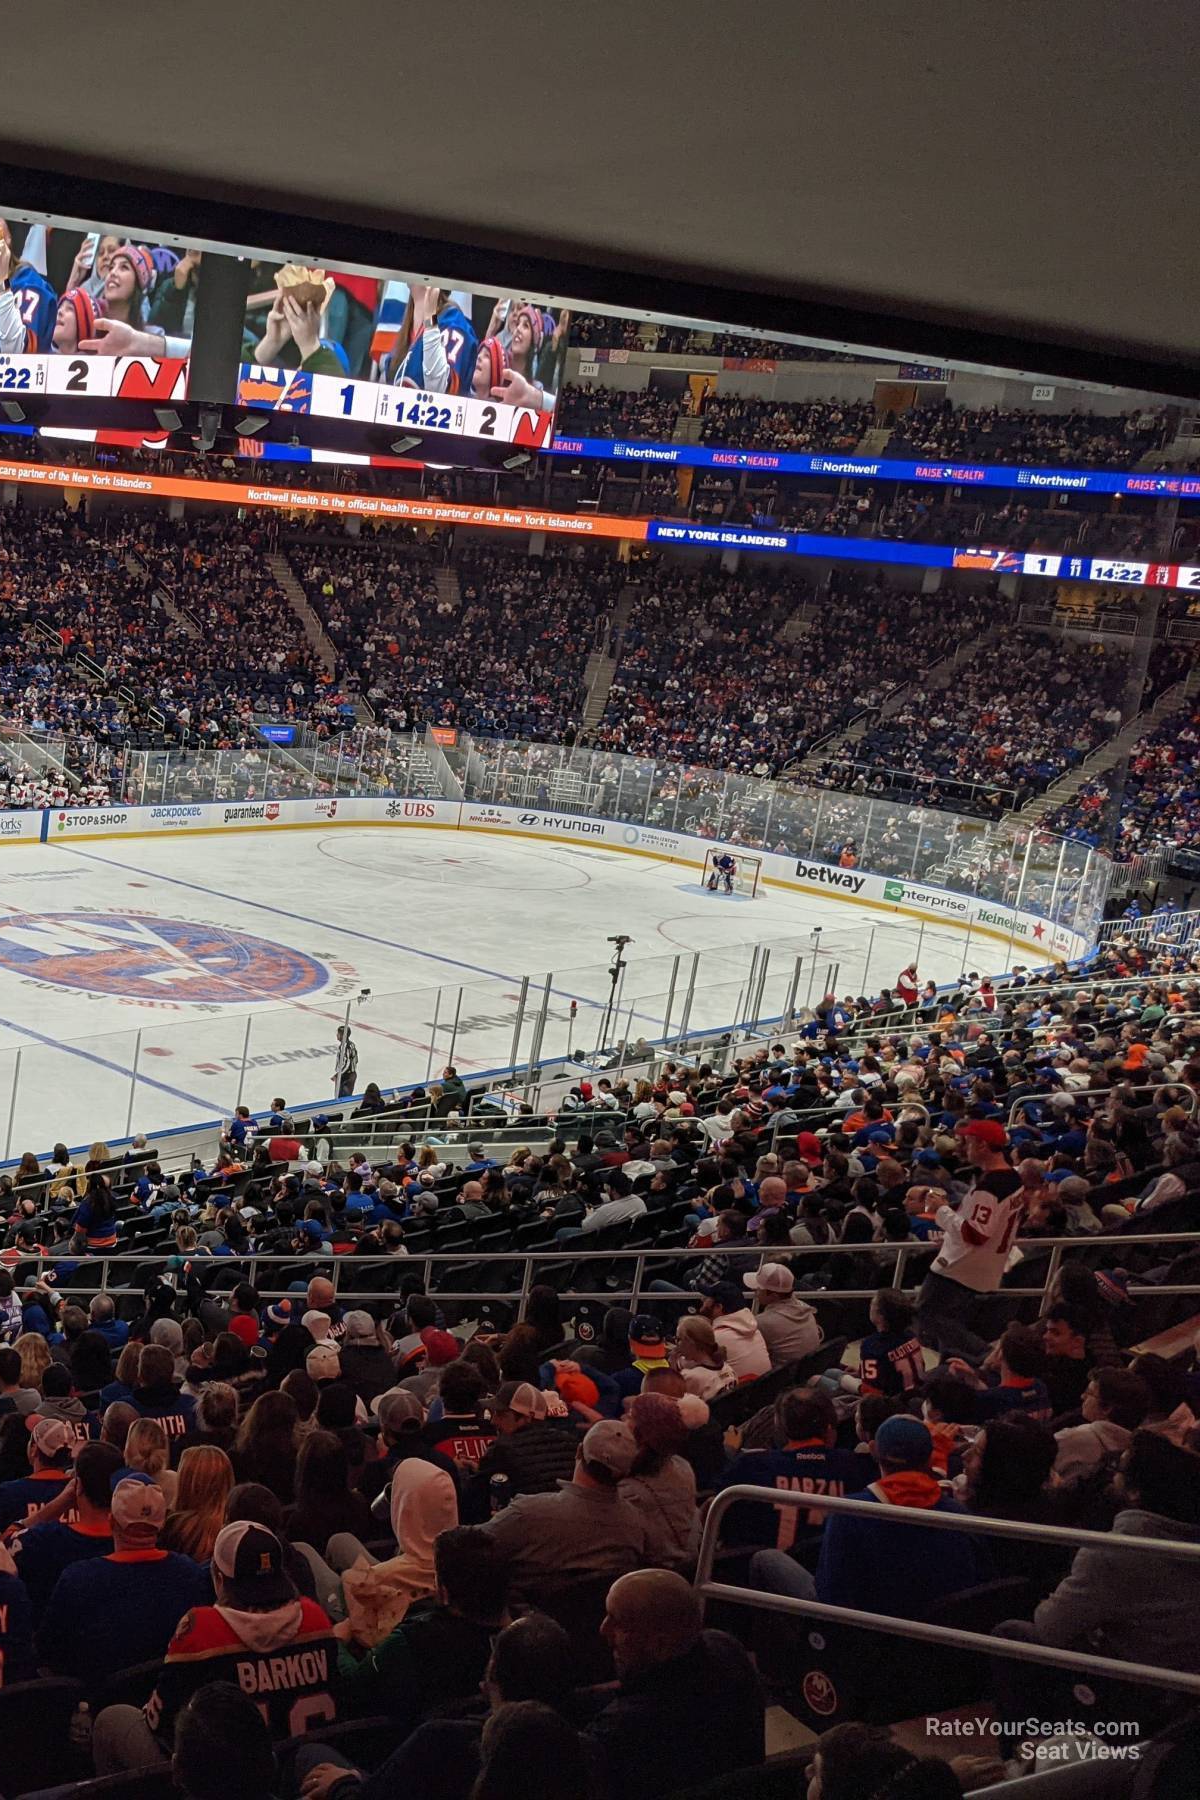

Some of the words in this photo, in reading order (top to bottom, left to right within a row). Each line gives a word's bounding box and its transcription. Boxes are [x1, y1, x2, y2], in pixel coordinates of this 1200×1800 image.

[66, 359, 89, 391] 2
[340, 385, 354, 415] 1
[396, 401, 452, 430] 14:22
[480, 406, 497, 435] 2
[625, 447, 677, 460] Northwell
[712, 453, 738, 465] RAISE
[746, 455, 779, 467] HEALTH
[822, 460, 878, 475] Northwell
[915, 467, 943, 479] RAISE
[952, 469, 985, 481] HEALTH
[0, 467, 16, 476] care
[18, 468, 46, 480] partner
[49, 470, 57, 480] of
[59, 471, 70, 481] the
[72, 472, 90, 484] New
[92, 474, 111, 486] York
[113, 477, 152, 490] Islanders
[1030, 473, 1087, 488] Northwell
[1127, 479, 1156, 492] RAISE
[248, 490, 288, 502] Northwell
[291, 493, 319, 506] Health
[332, 497, 345, 508] the
[348, 499, 378, 511] official
[381, 502, 409, 514] health
[412, 506, 433, 515] care
[435, 508, 470, 519] partner
[474, 510, 483, 520] of
[486, 511, 500, 521] the
[503, 512, 522, 524] New
[525, 514, 545, 526] York
[548, 517, 593, 530] Islanders
[658, 527, 686, 538] NEW
[688, 530, 719, 542] YORK
[721, 533, 787, 547] ISLANDERS
[1037, 558, 1047, 572] 1
[1095, 567, 1142, 582] 14:22
[66, 814, 127, 826] STOP&SHOP
[224, 804, 264, 822] guaranteed
[404, 803, 435, 817] UBS
[543, 817, 605, 835] HYUNDAI
[795, 861, 866, 894] betway
[890, 886, 967, 911] enterprise
[978, 908, 1028, 935] Heineken
[971, 1204, 992, 1225] 13
[237, 1648, 328, 1695] BARKOV
